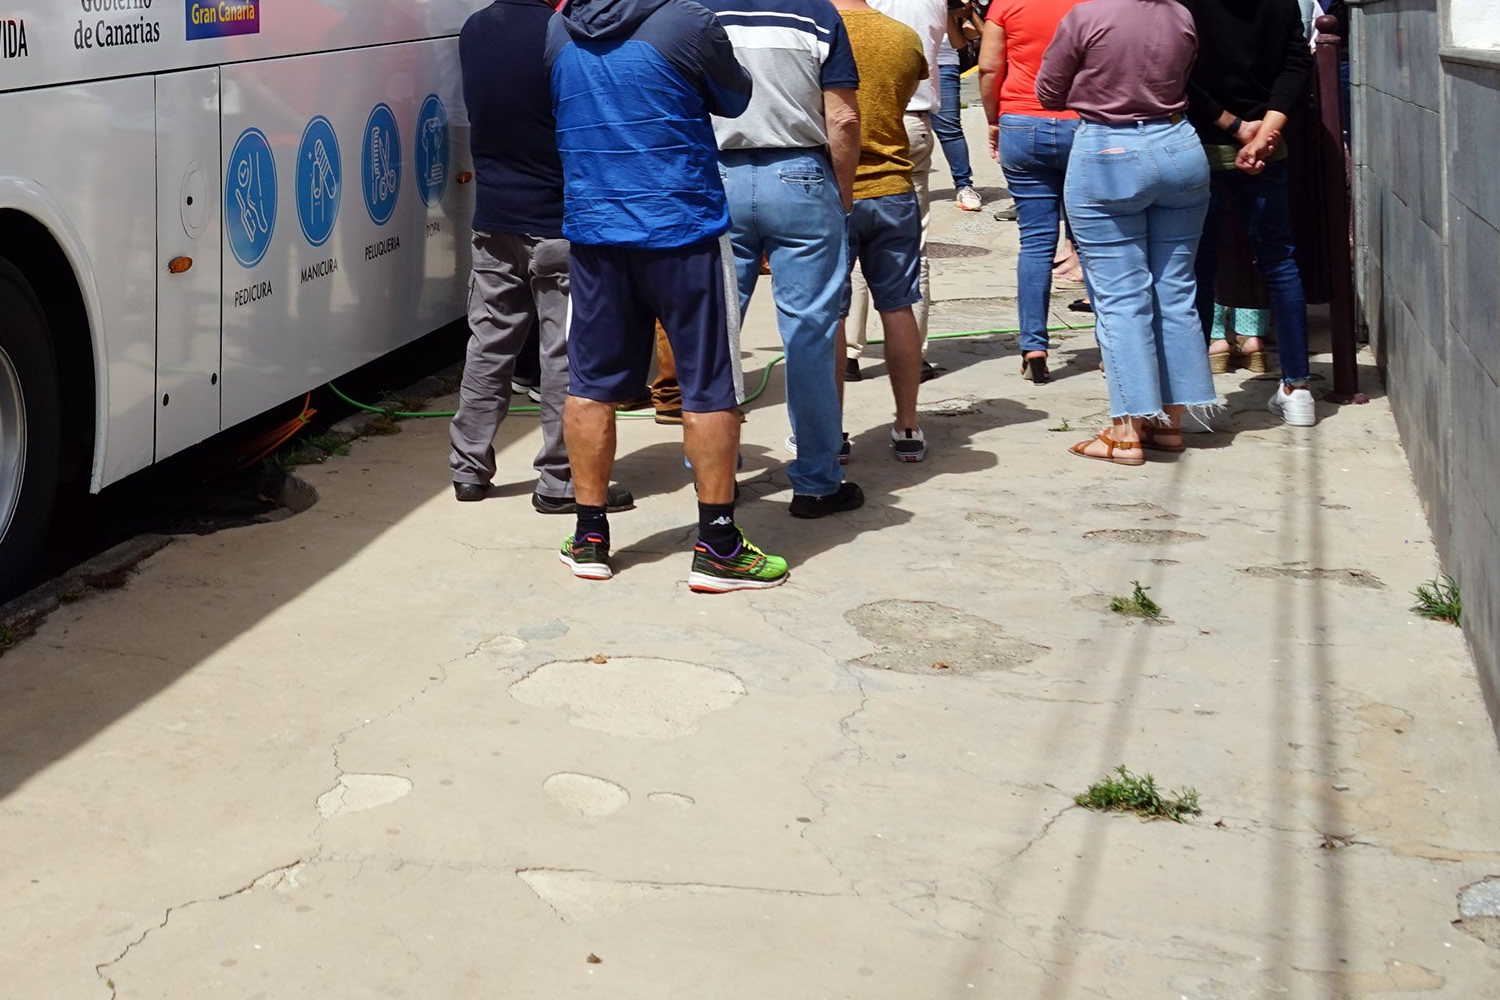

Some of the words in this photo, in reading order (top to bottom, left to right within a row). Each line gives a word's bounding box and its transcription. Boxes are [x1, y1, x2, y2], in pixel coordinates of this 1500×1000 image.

[191, 3, 217, 25] Gran
[217, 0, 255, 23] Canaria
[74, 20, 93, 50] de
[95, 16, 160, 48] Canarias
[300, 258, 339, 284] MANICURA
[234, 281, 273, 308] PEDICURA
